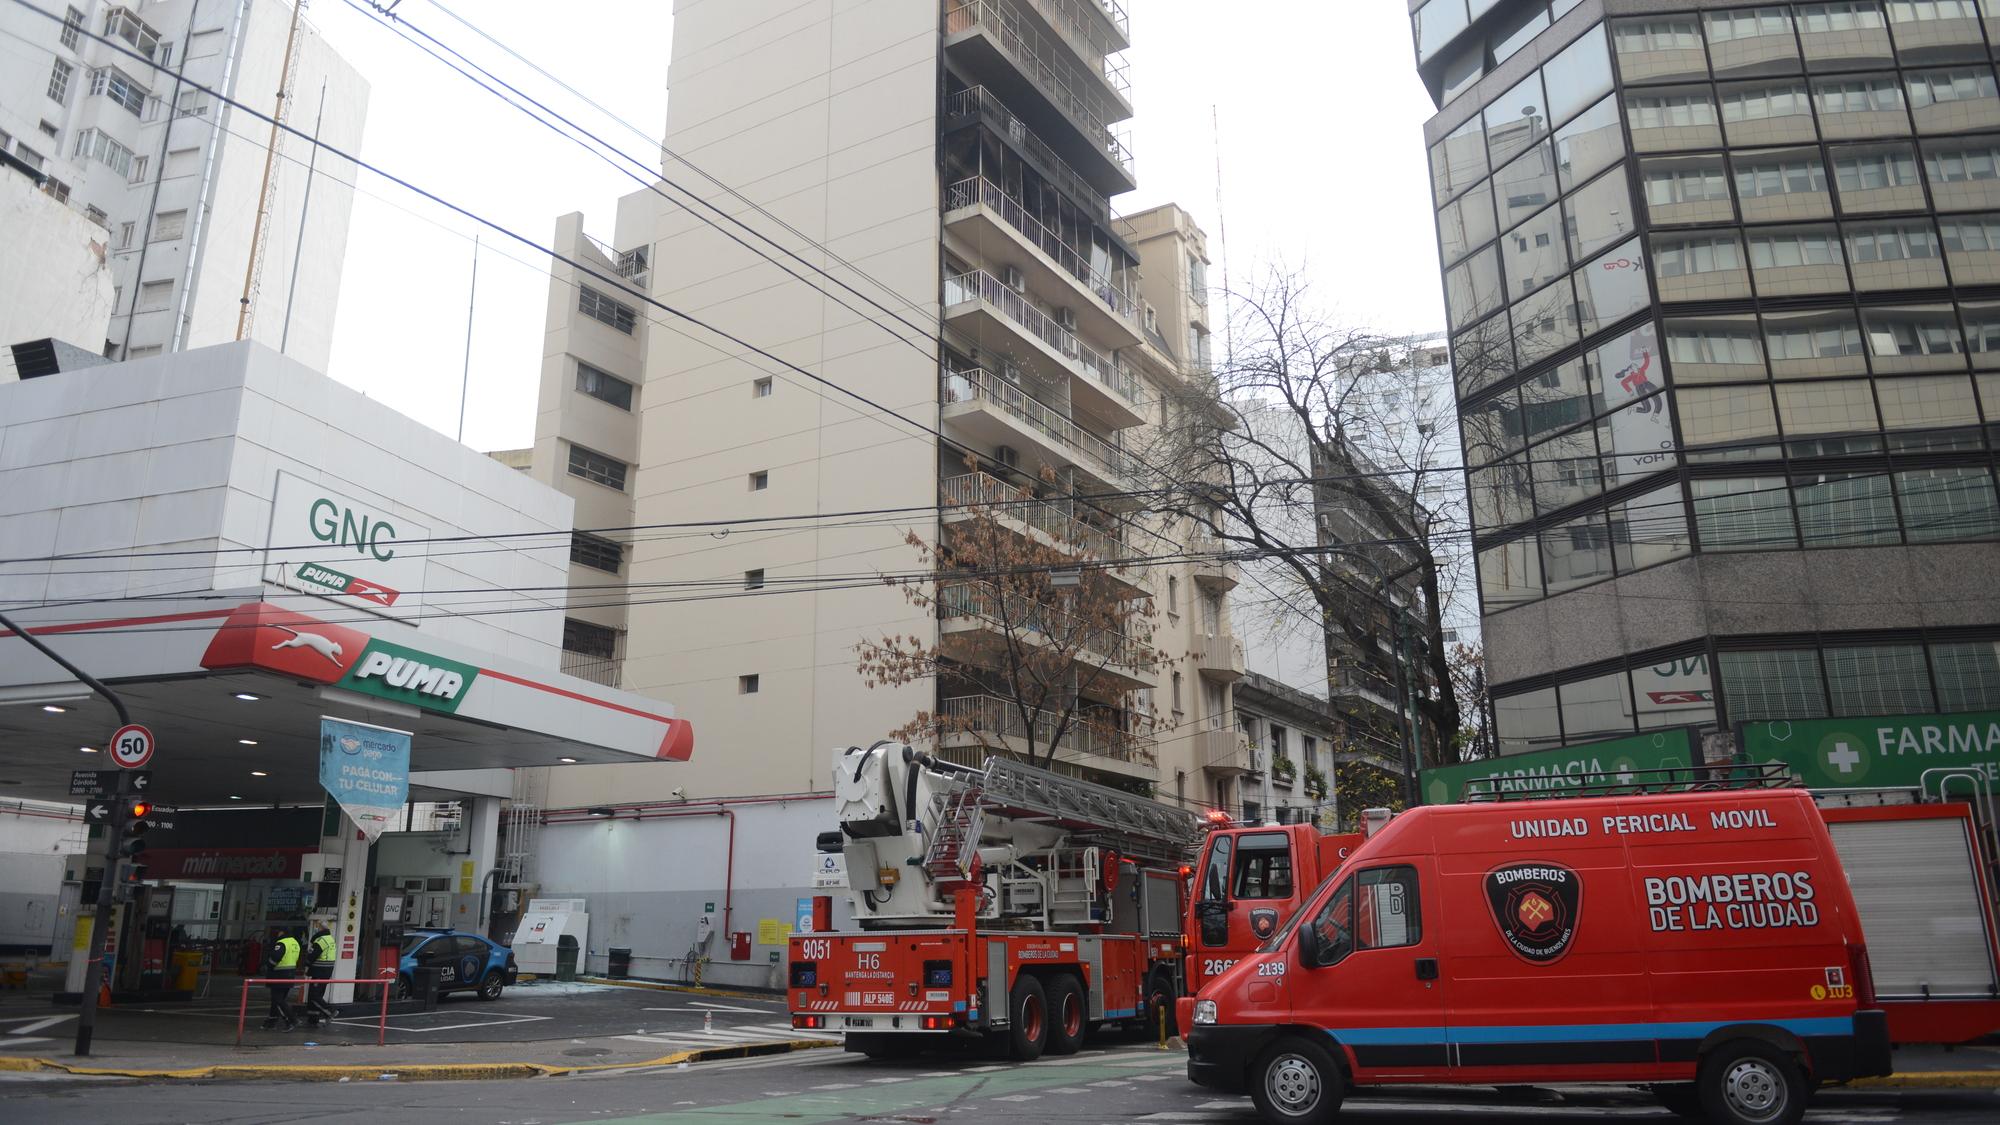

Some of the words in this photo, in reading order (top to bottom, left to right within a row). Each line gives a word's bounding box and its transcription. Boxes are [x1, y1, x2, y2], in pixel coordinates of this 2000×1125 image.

[310, 498, 396, 562] GNC
[303, 567, 346, 588] PUMA
[354, 651, 463, 699] PUMA
[120, 737, 145, 756] 50
[363, 740, 396, 753] mercado
[363, 749, 383, 760] pago
[371, 769, 393, 781] CON
[1489, 758, 1606, 793] FARMACIA
[339, 778, 353, 790] TU
[356, 779, 398, 795] CELULAR
[152, 805, 175, 813] Ecuador
[1510, 817, 1590, 839] UNIDAD
[1602, 812, 1697, 835] PERICIAL
[1710, 809, 1777, 831] MOVIL
[182, 851, 286, 873] minimercado
[1495, 868, 1566, 884] BOMBEROS
[1644, 871, 1815, 906] BOMBEROS
[385, 904, 400, 912] GNC
[1649, 905, 1685, 932] DE
[1688, 903, 1724, 930] LA
[1726, 900, 1819, 930] CIUDAD
[803, 939, 831, 960] 9051
[1516, 941, 1536, 955] CIUDAD
[1543, 940, 1564, 955] BUENOS
[858, 954, 880, 970] H6
[1258, 962, 1285, 976] 2139
[441, 966, 455, 976] CIA
[844, 971, 867, 979] MANTENGA
[873, 971, 895, 979] DISTANCIA
[865, 993, 877, 1004] ALP
[878, 993, 893, 1004] 540E
[1829, 985, 1853, 998] 103
